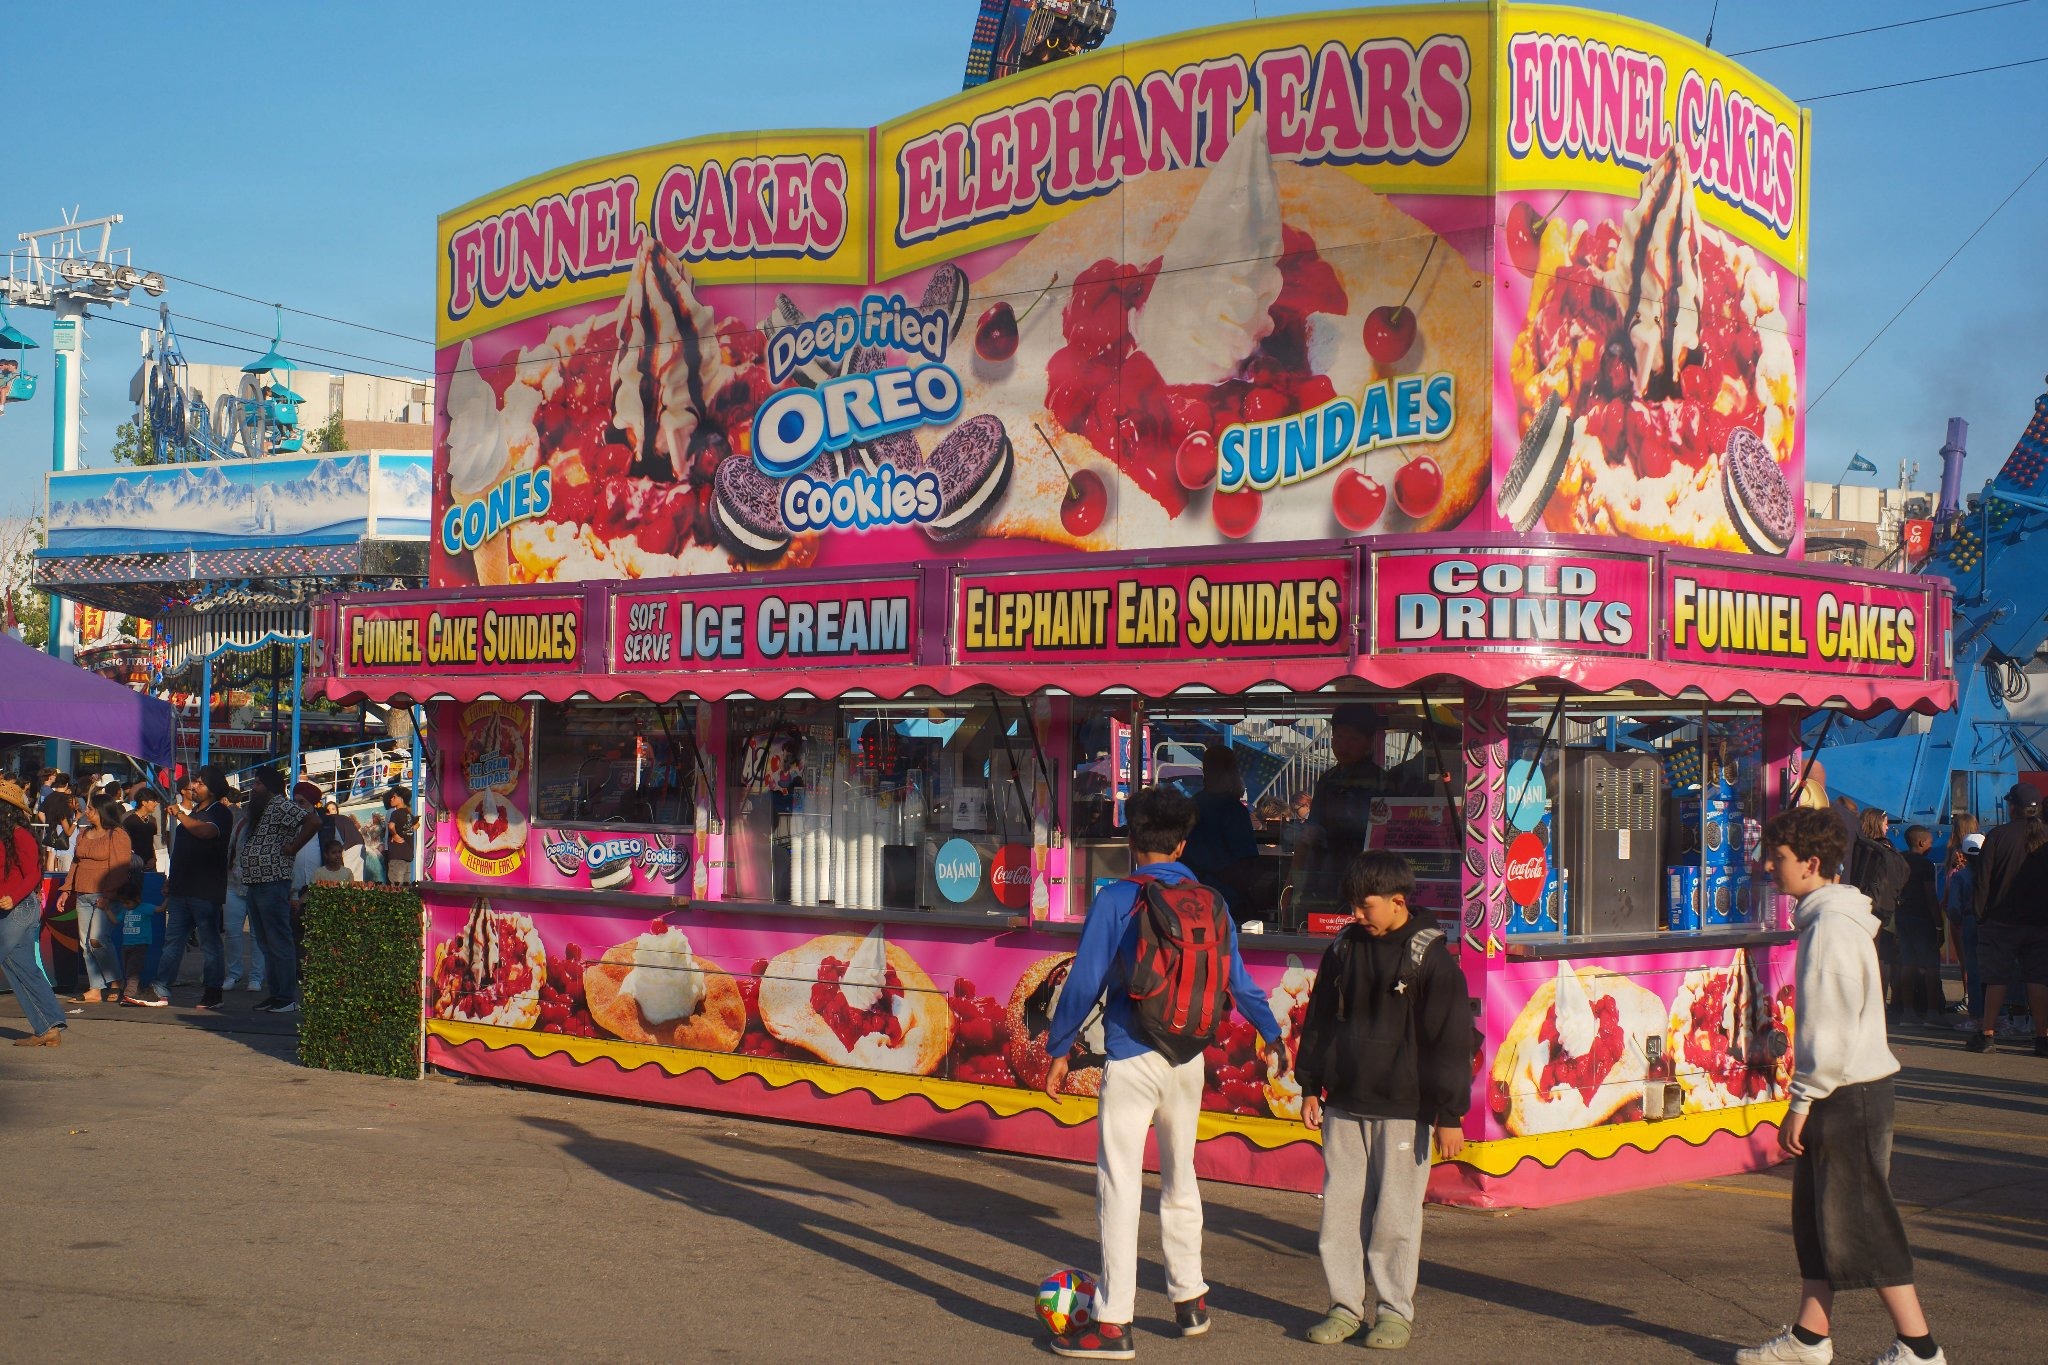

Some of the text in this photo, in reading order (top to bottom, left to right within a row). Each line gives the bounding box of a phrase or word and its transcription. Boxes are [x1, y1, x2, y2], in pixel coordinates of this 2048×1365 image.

[896, 34, 1471, 248] ELEPHANT EARS
[1507, 31, 1797, 239] FUNNEL CAKES
[448, 154, 848, 319] FUNNEL CAKES
[770, 299, 944, 380] Deep Fried
[757, 366, 958, 464] OREO
[1217, 370, 1456, 493] SUNDAES
[442, 465, 552, 555] CONES
[783, 468, 939, 527] Cookies
[1430, 560, 1596, 596] COLD
[352, 607, 578, 665] FUNNEL CAKE SUNDAES
[629, 601, 668, 632] SOFT
[680, 595, 909, 659] ICE CREAM
[966, 575, 1342, 652] ELEPHANT EAR SUNDAES
[1396, 594, 1633, 645] DRINKS
[1672, 576, 1807, 658] FUNNEL
[1815, 590, 1917, 666] CAKES
[623, 632, 672, 663] SERVE
[470, 757, 510, 776] ICE CREAM
[470, 771, 510, 789] SUNDAES
[1508, 780, 1545, 809] DASANI
[466, 854, 515, 875] ELEPHANT EARS
[546, 839, 683, 866] Deep Fried OREO Cookies
[938, 858, 977, 884] DASANI
[1507, 857, 1545, 881] Coca-Cola
